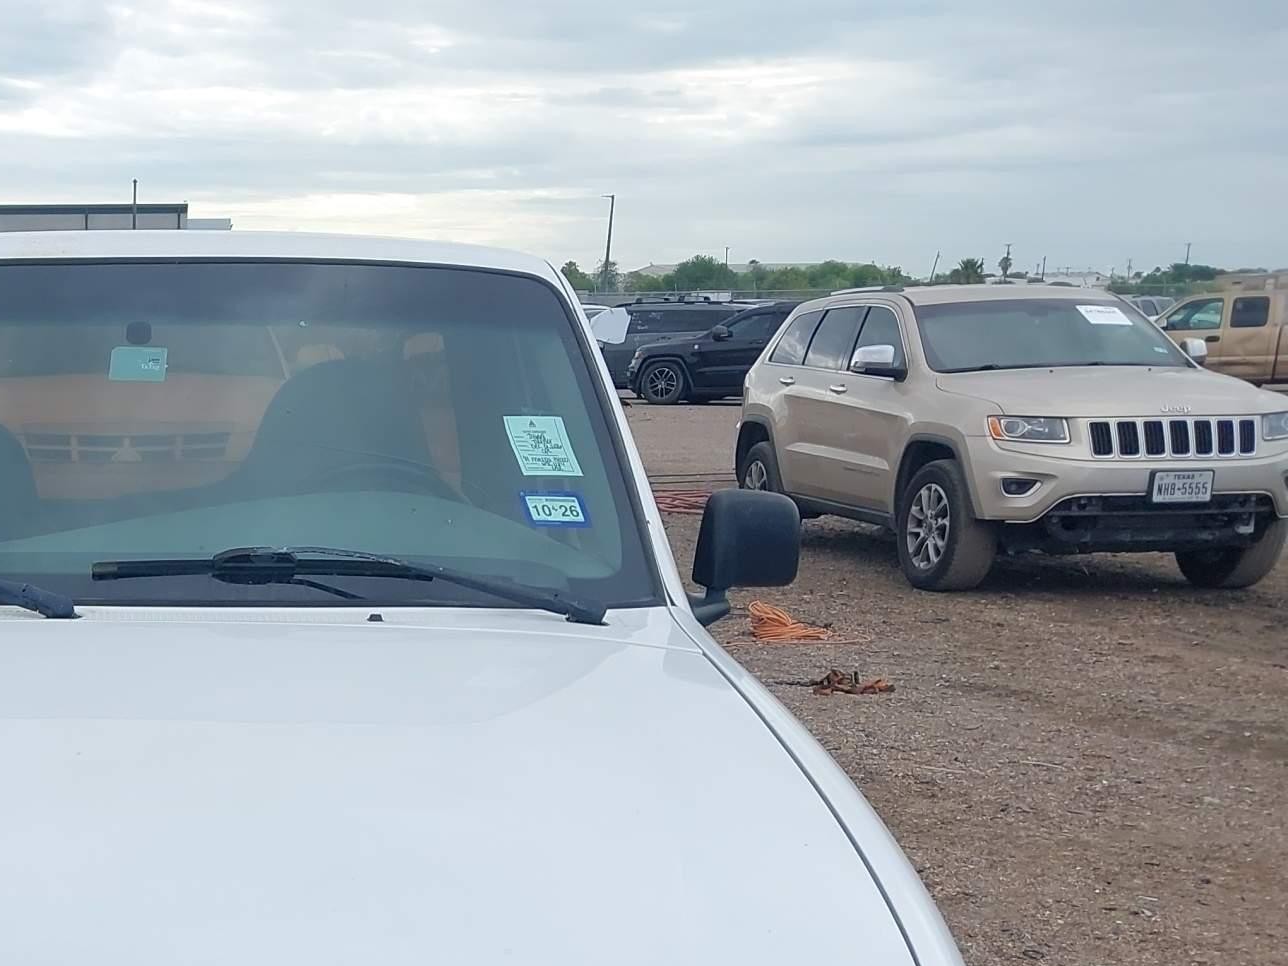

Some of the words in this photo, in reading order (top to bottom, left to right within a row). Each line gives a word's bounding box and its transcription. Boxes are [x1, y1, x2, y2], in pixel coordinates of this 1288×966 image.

[1160, 404, 1192, 413] Jeep
[531, 504, 552, 517] 10
[559, 505, 580, 517] 26
